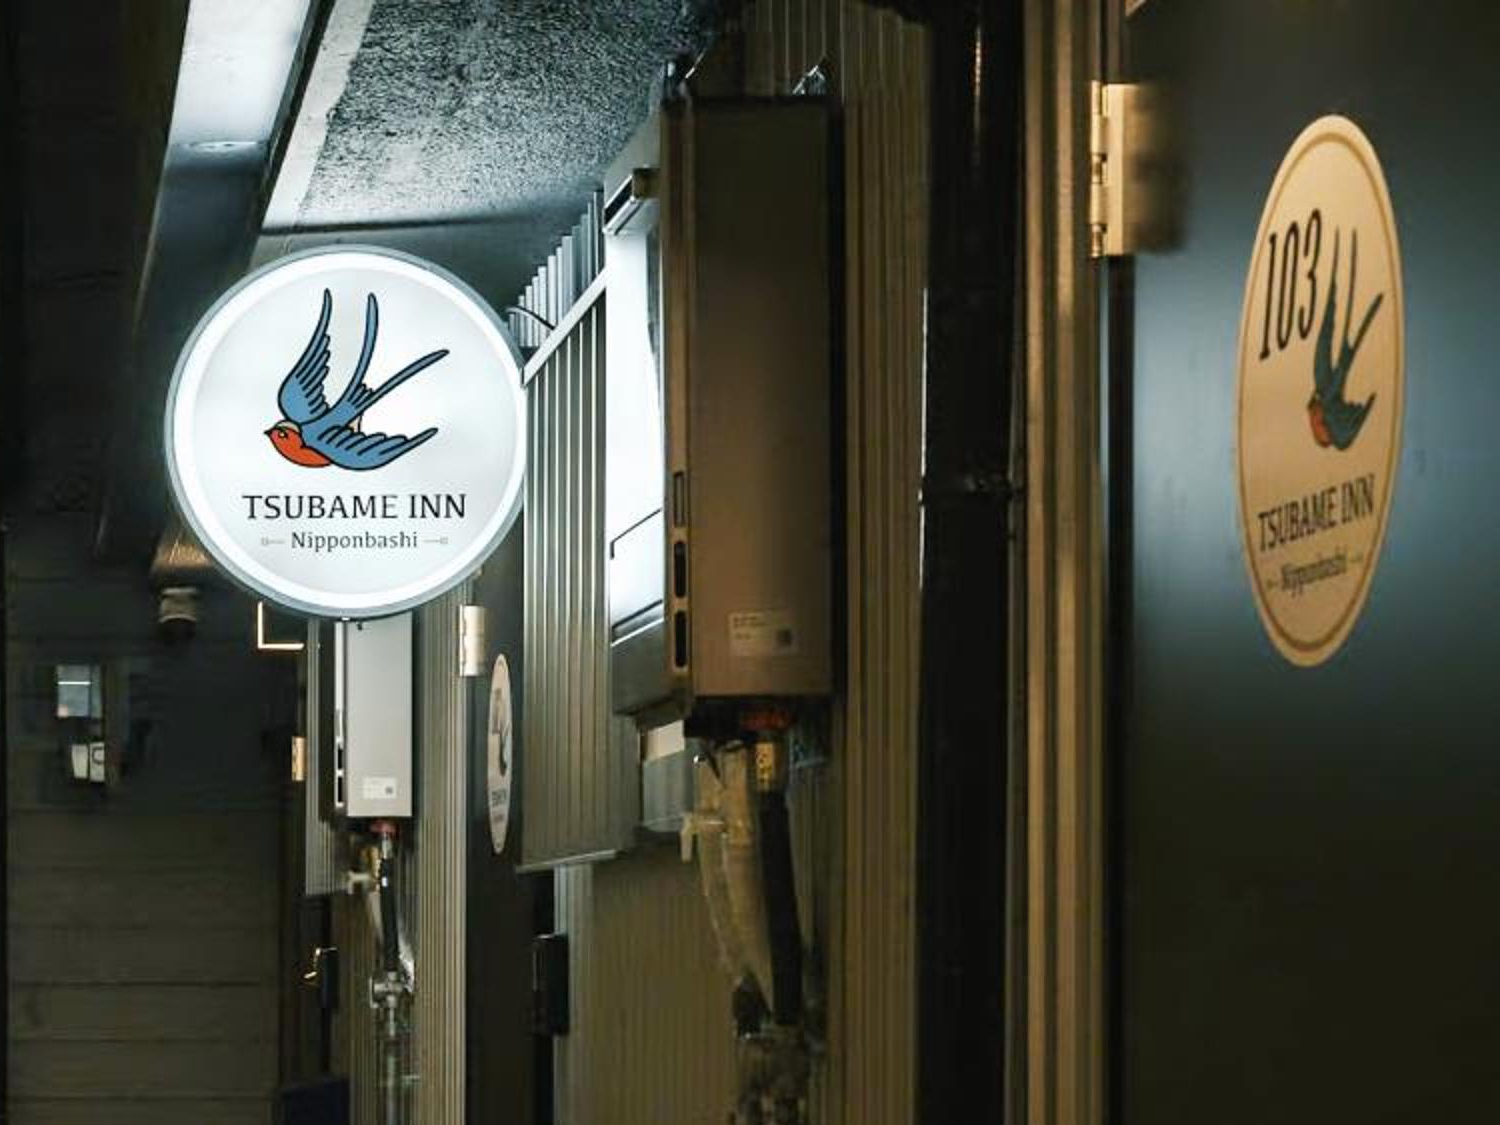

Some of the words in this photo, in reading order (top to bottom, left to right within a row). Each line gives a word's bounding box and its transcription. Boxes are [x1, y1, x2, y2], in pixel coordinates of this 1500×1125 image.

[1259, 208, 1322, 362] 103
[241, 494, 398, 520] TSUBAME
[408, 493, 466, 519] INN
[1258, 486, 1337, 552] TSUBAME
[1341, 473, 1375, 524] INN
[291, 531, 417, 552] Nipponbashi
